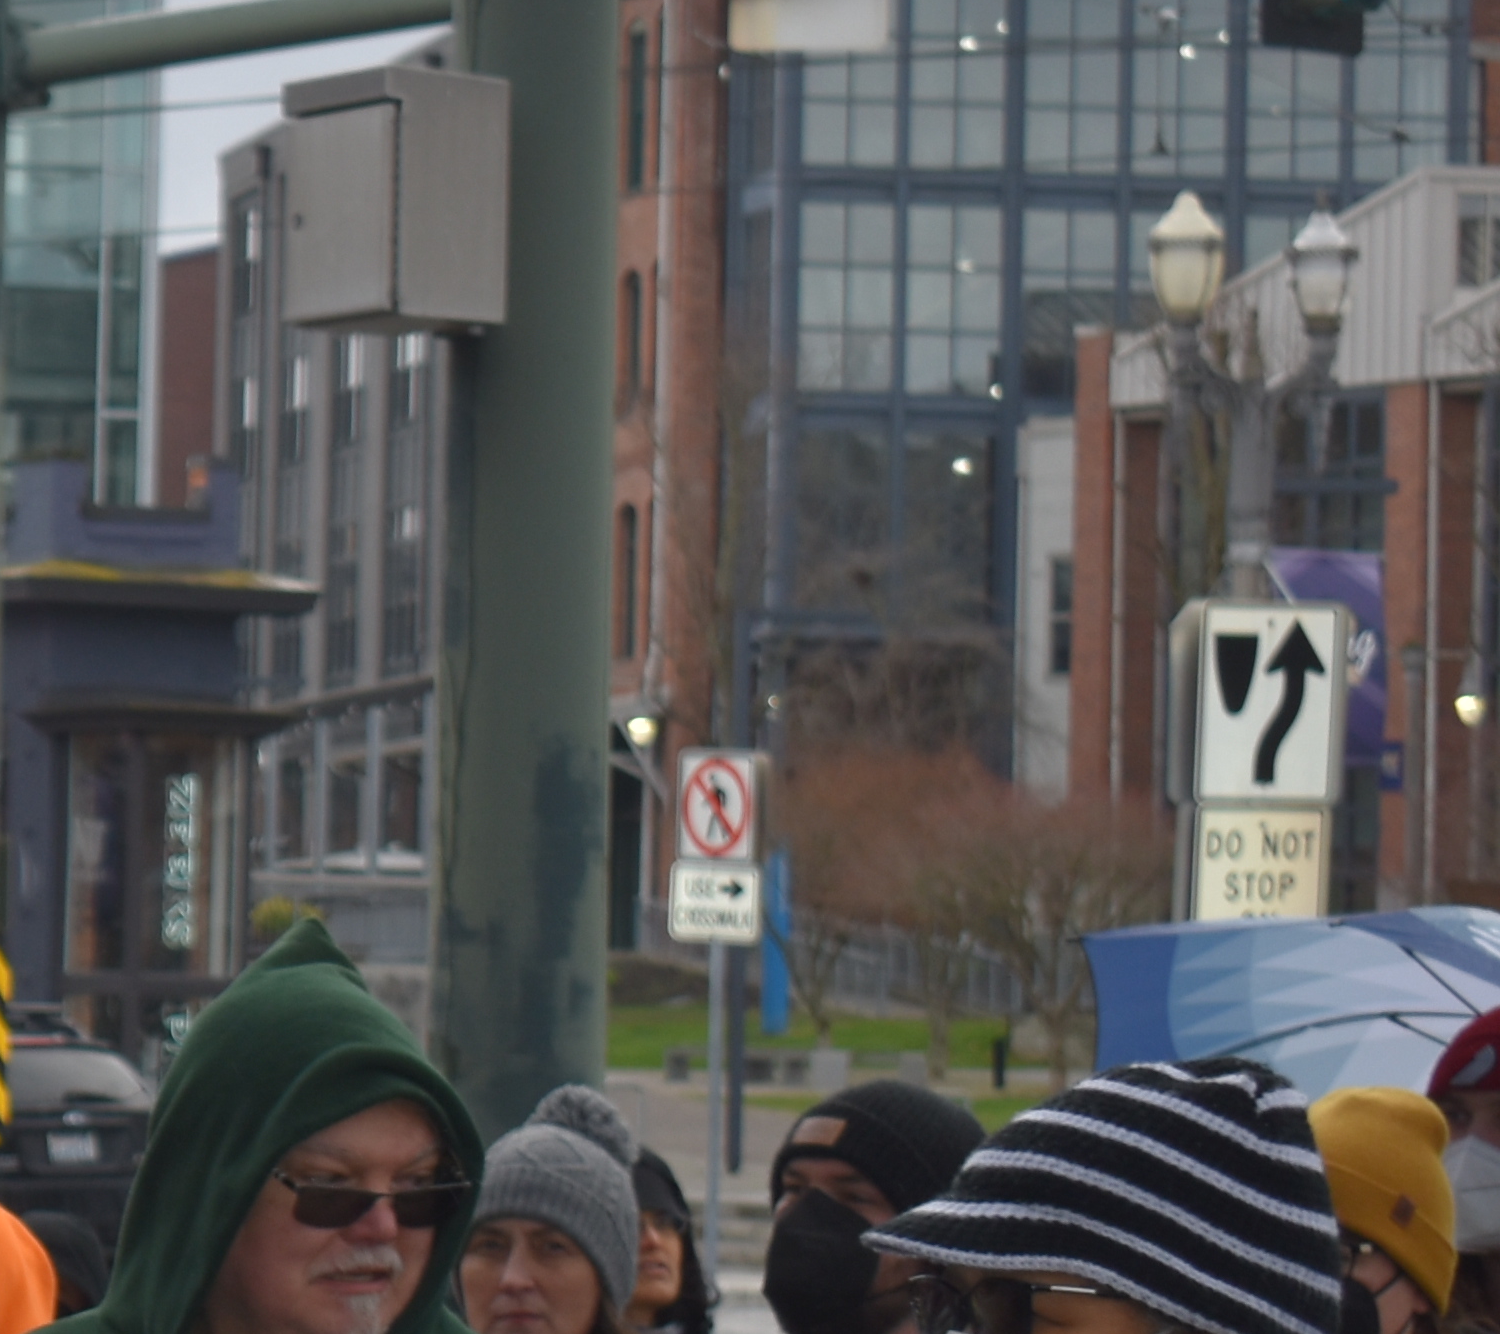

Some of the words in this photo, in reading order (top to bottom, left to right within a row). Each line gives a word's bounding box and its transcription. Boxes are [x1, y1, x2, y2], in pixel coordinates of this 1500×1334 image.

[1205, 829, 1243, 859] DO
[1260, 827, 1316, 859] NOT
[1223, 871, 1297, 902] STOP
